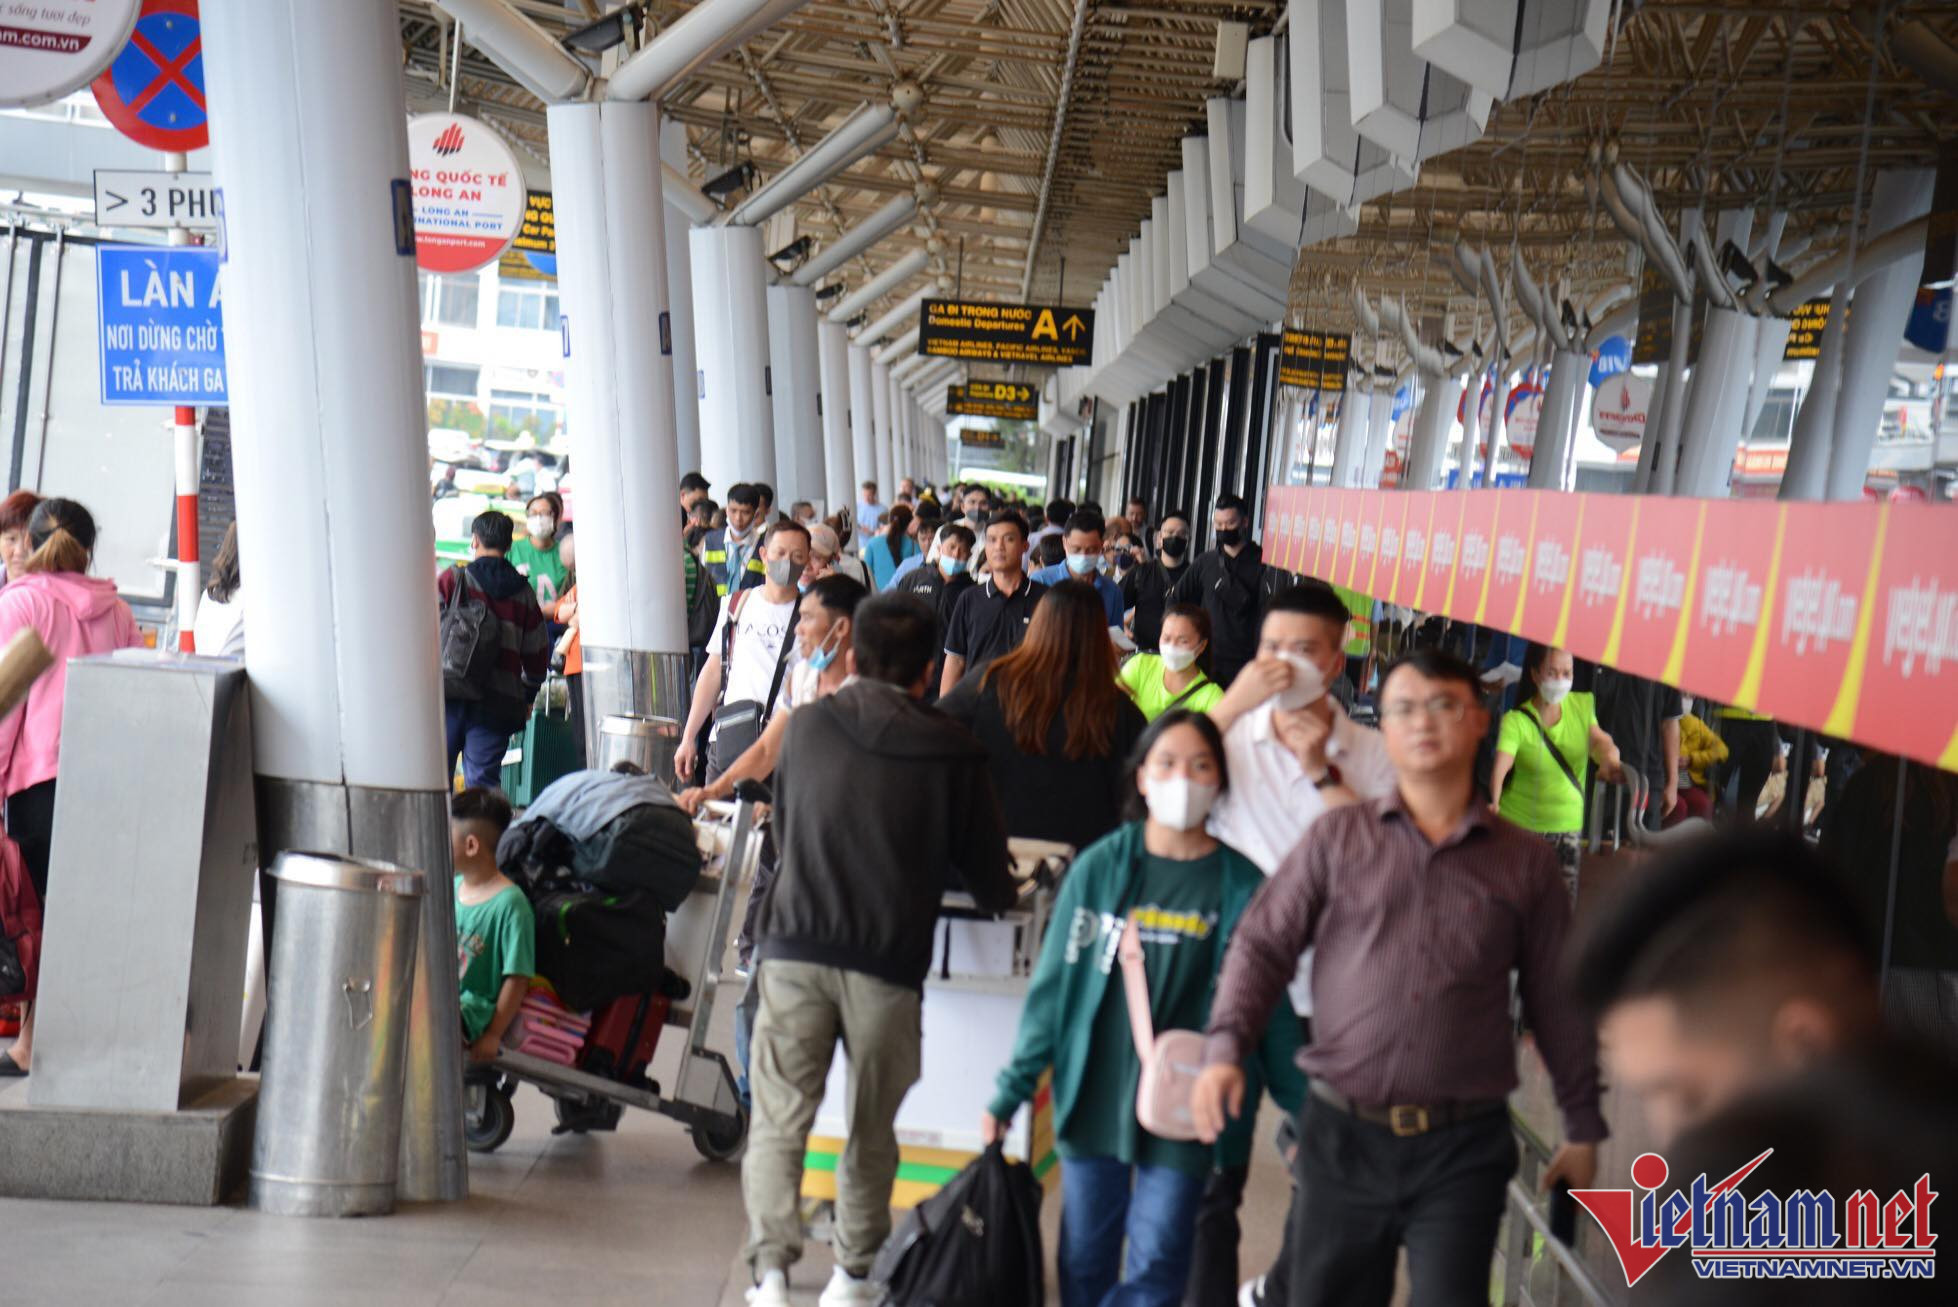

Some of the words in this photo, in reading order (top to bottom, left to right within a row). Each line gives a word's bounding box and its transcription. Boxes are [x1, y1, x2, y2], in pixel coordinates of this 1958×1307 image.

[140, 187, 157, 217] 3
[459, 189, 482, 202] AN
[120, 258, 195, 309] LÀN
[928, 315, 972, 328] Domestic
[974, 318, 1025, 332] Departures
[929, 303, 945, 315] GA
[961, 305, 998, 318] TRONG
[1031, 308, 1059, 341] A
[106, 323, 134, 351] NƠI
[138, 317, 182, 352] DỪNG
[186, 318, 218, 352] CHỜ
[112, 357, 143, 392] TRẢ
[147, 359, 199, 393] KHÁCH
[203, 367, 225, 393] GA
